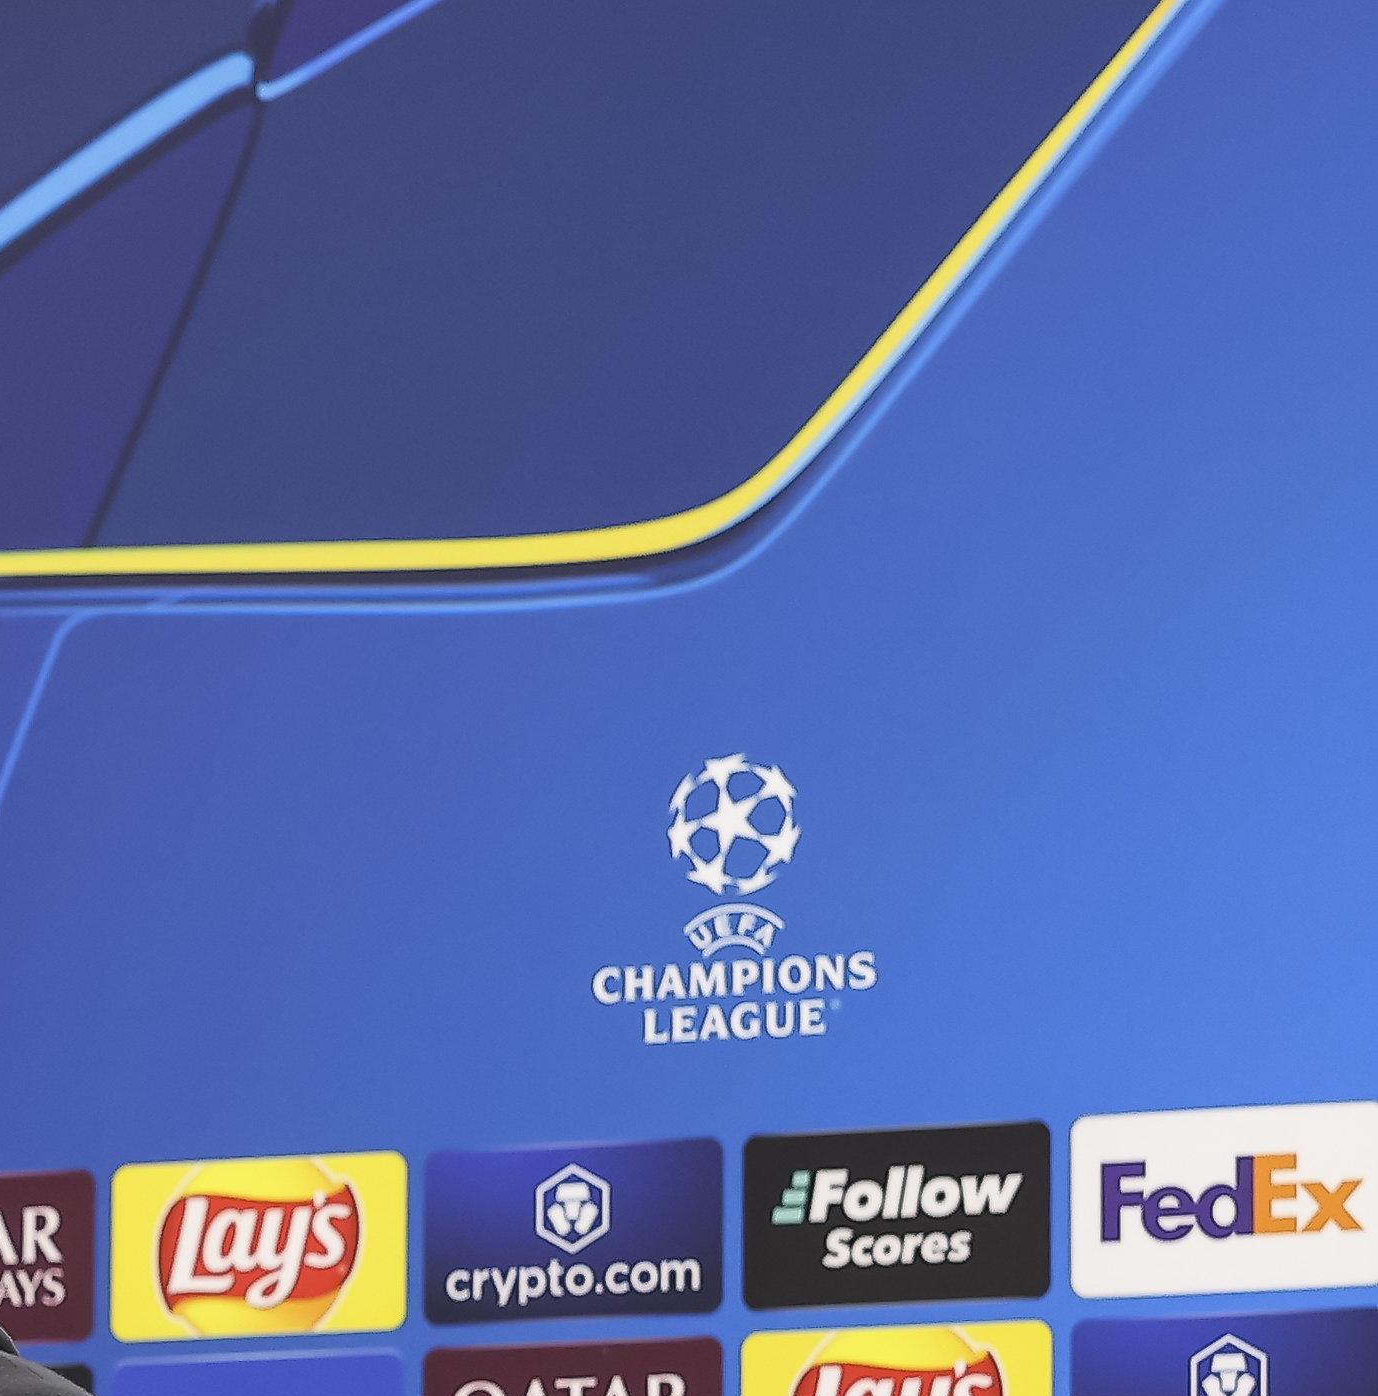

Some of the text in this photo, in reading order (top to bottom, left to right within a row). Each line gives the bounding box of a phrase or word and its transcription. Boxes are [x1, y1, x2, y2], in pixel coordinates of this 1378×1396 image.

[688, 913, 777, 952] UEFA
[592, 950, 878, 1005] CHAMPIONS
[644, 998, 828, 1045] LEAGUE
[809, 1163, 1023, 1223] Follow
[1100, 1153, 1363, 1243] FedEx
[168, 1189, 354, 1309] Lay's
[822, 1227, 972, 1269] Scores
[444, 1256, 702, 1307] crypto.com
